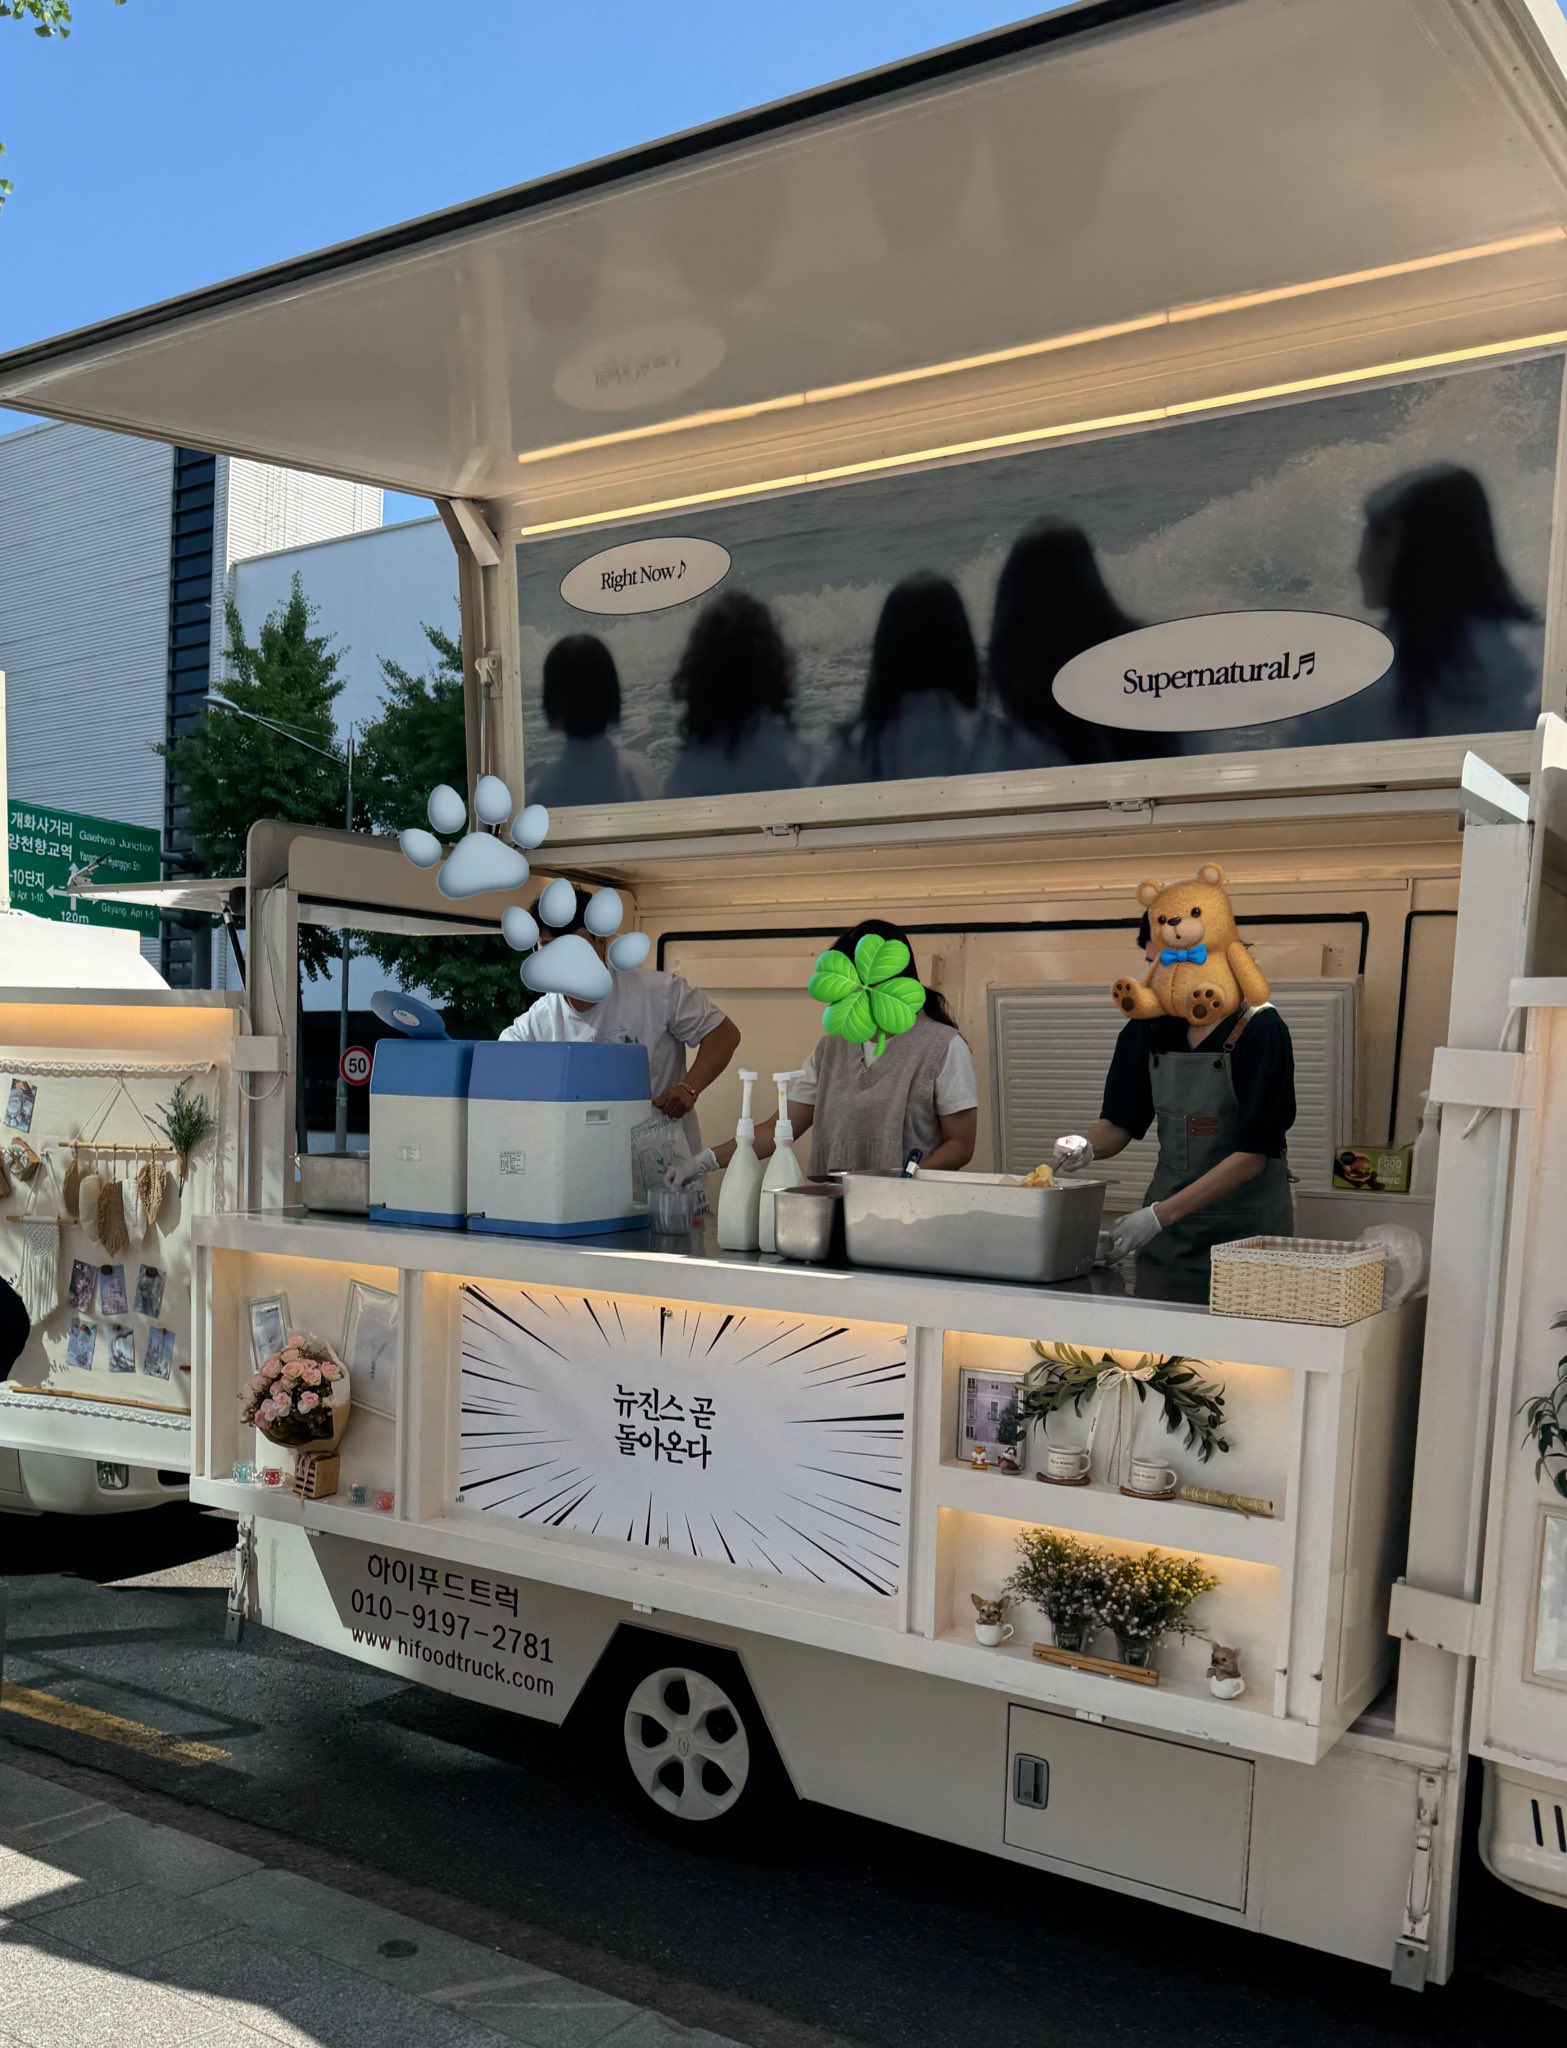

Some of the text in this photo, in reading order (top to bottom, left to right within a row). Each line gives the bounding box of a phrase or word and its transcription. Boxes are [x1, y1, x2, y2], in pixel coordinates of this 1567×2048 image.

[601, 565, 676, 592] Right Now
[1123, 652, 1290, 698] Supernatural
[11, 812, 73, 839] 개화사거리
[8, 833, 72, 862] 양천향교역
[79, 830, 154, 854] Gaehwa Junction
[9, 868, 45, 889] -10단지
[60, 911, 90, 925] 120m
[101, 902, 127, 917] Gayang
[348, 1058, 367, 1073] 50
[613, 1384, 716, 1430] 뉴진스 곧
[614, 1423, 712, 1470] 돌아온다
[367, 1554, 518, 1618] 하이푸드트럭
[351, 1588, 554, 1664] 010-9197-2781
